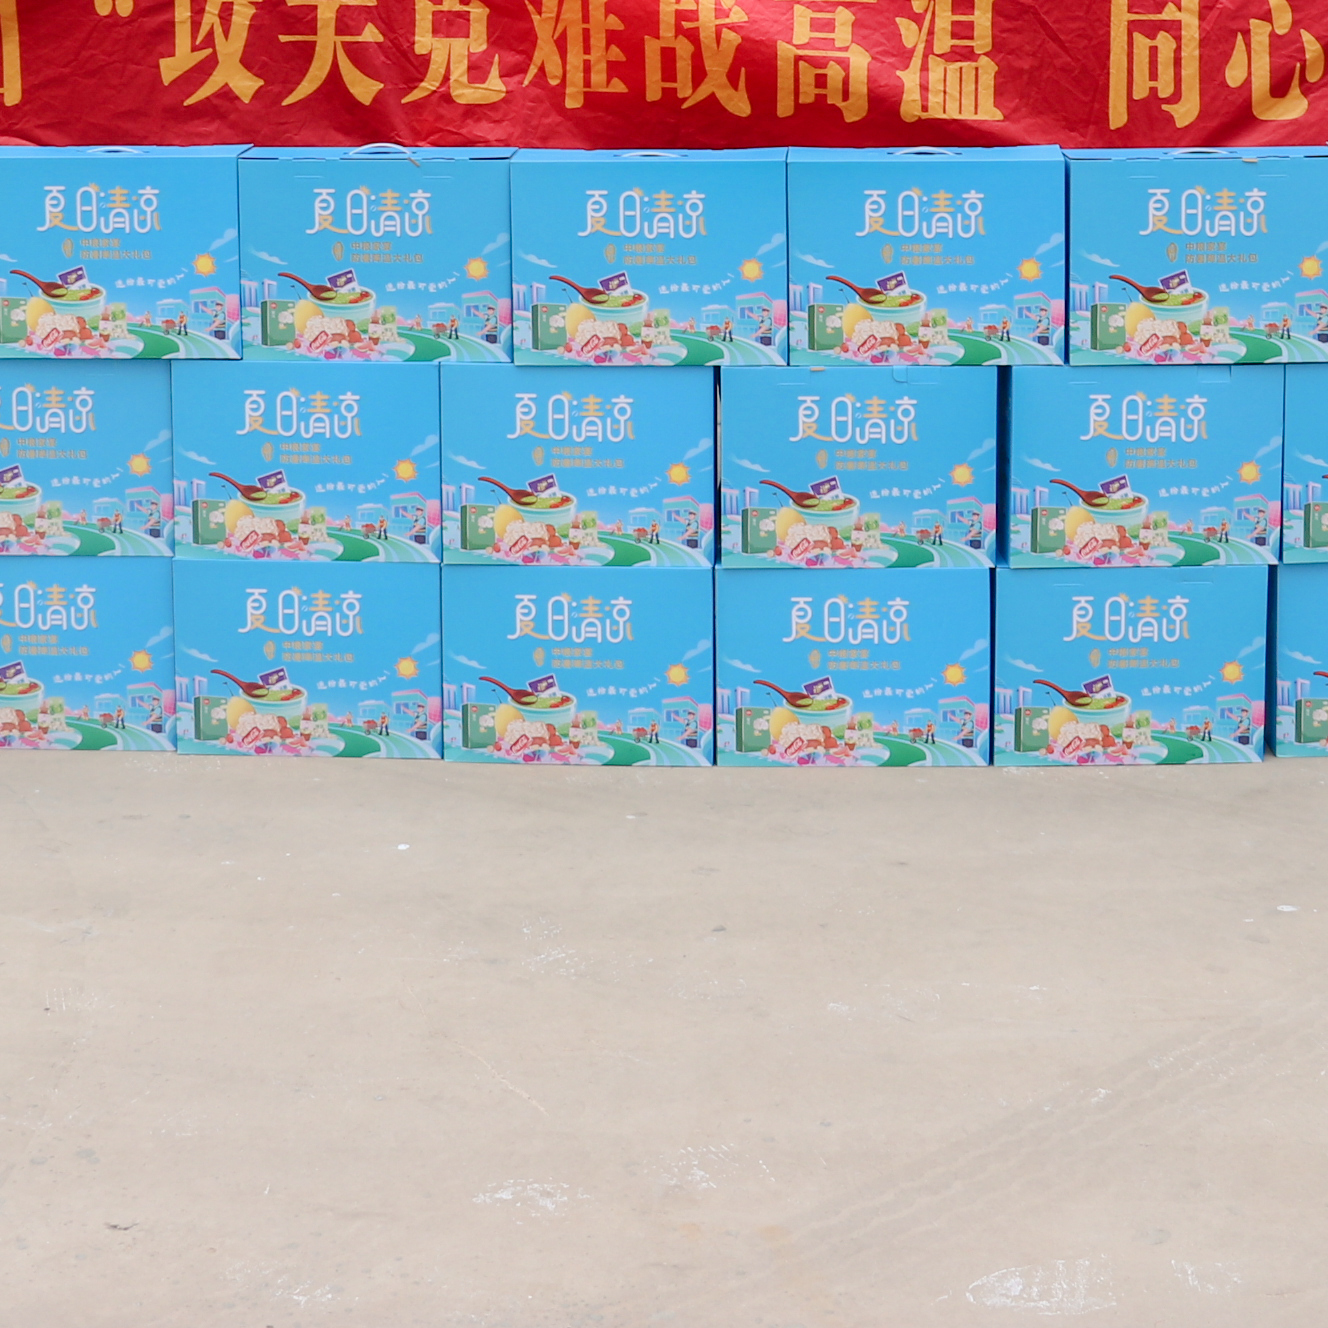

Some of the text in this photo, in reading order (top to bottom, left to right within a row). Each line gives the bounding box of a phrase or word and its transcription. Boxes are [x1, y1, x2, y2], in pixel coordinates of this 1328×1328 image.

[35, 182, 161, 235] 夏日清凉
[304, 185, 433, 238] 夏日清凉
[576, 187, 707, 240] 夏日清凉
[855, 187, 986, 240] 夏日清凉
[1138, 185, 1269, 238] 夏日清凉
[235, 387, 362, 439] 夏日清凉
[506, 390, 635, 443] 夏日清凉
[788, 393, 919, 445] 夏日清凉
[1080, 391, 1209, 443] 夏日清凉
[237, 586, 364, 637] 夏日清凉
[506, 592, 634, 644] 夏日清凉
[781, 594, 911, 645] 夏日清凉
[1063, 592, 1191, 644] 夏日清凉
